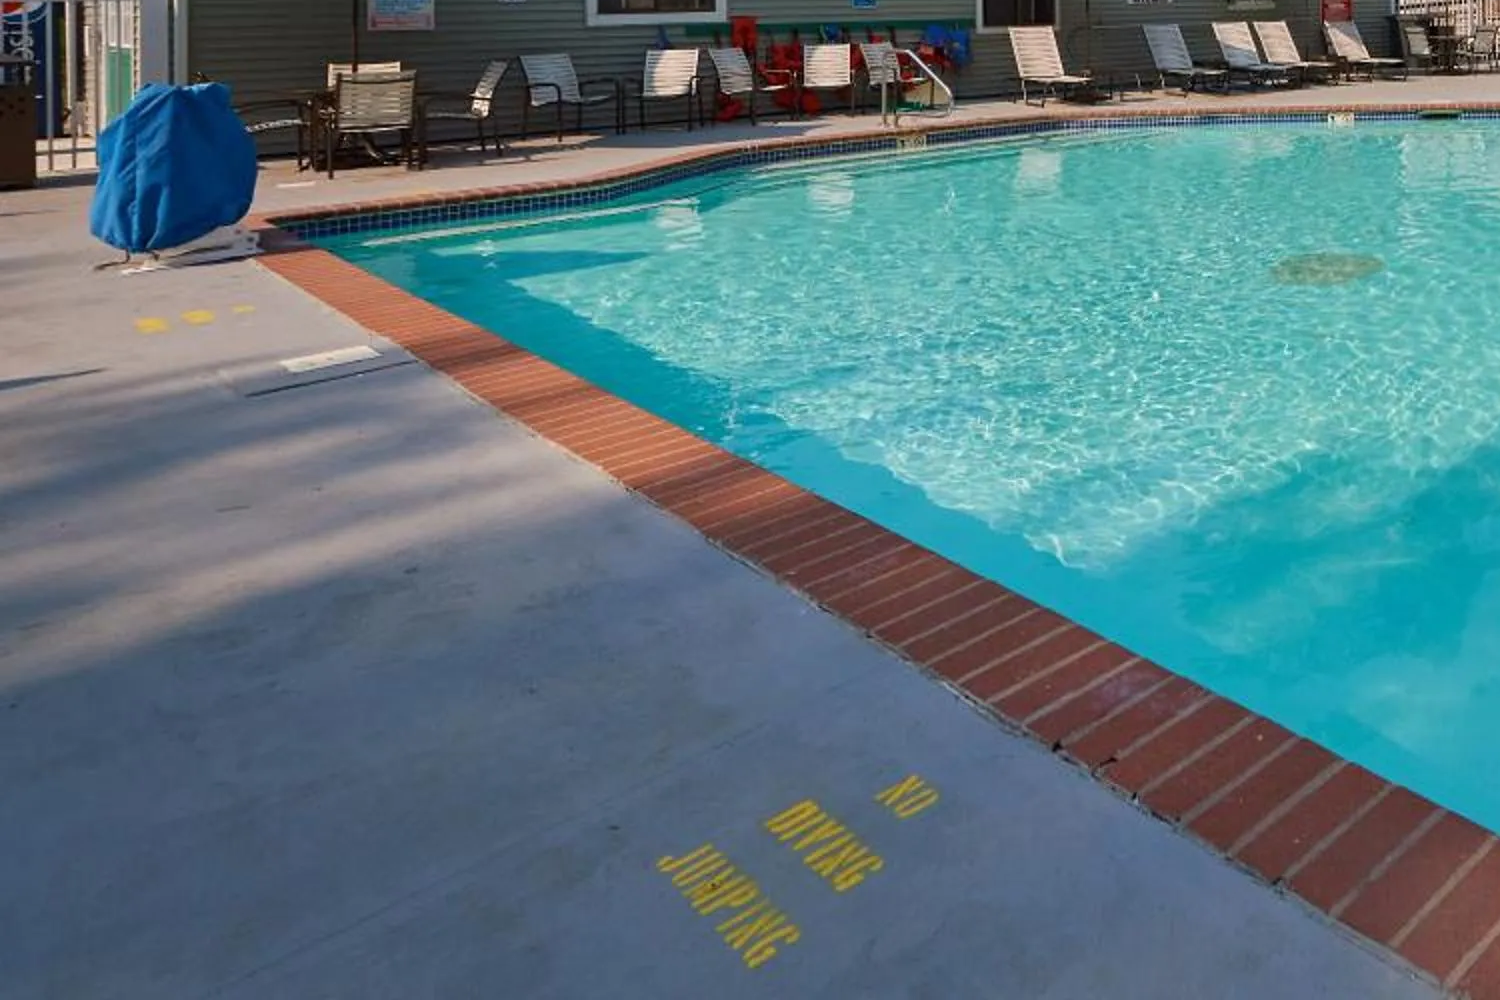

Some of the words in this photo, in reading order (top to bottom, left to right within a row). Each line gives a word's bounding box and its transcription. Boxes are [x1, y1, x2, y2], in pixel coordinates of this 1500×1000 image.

[874, 774, 939, 819] NO
[766, 798, 884, 892] DIVING
[656, 844, 800, 968] JUMPING
